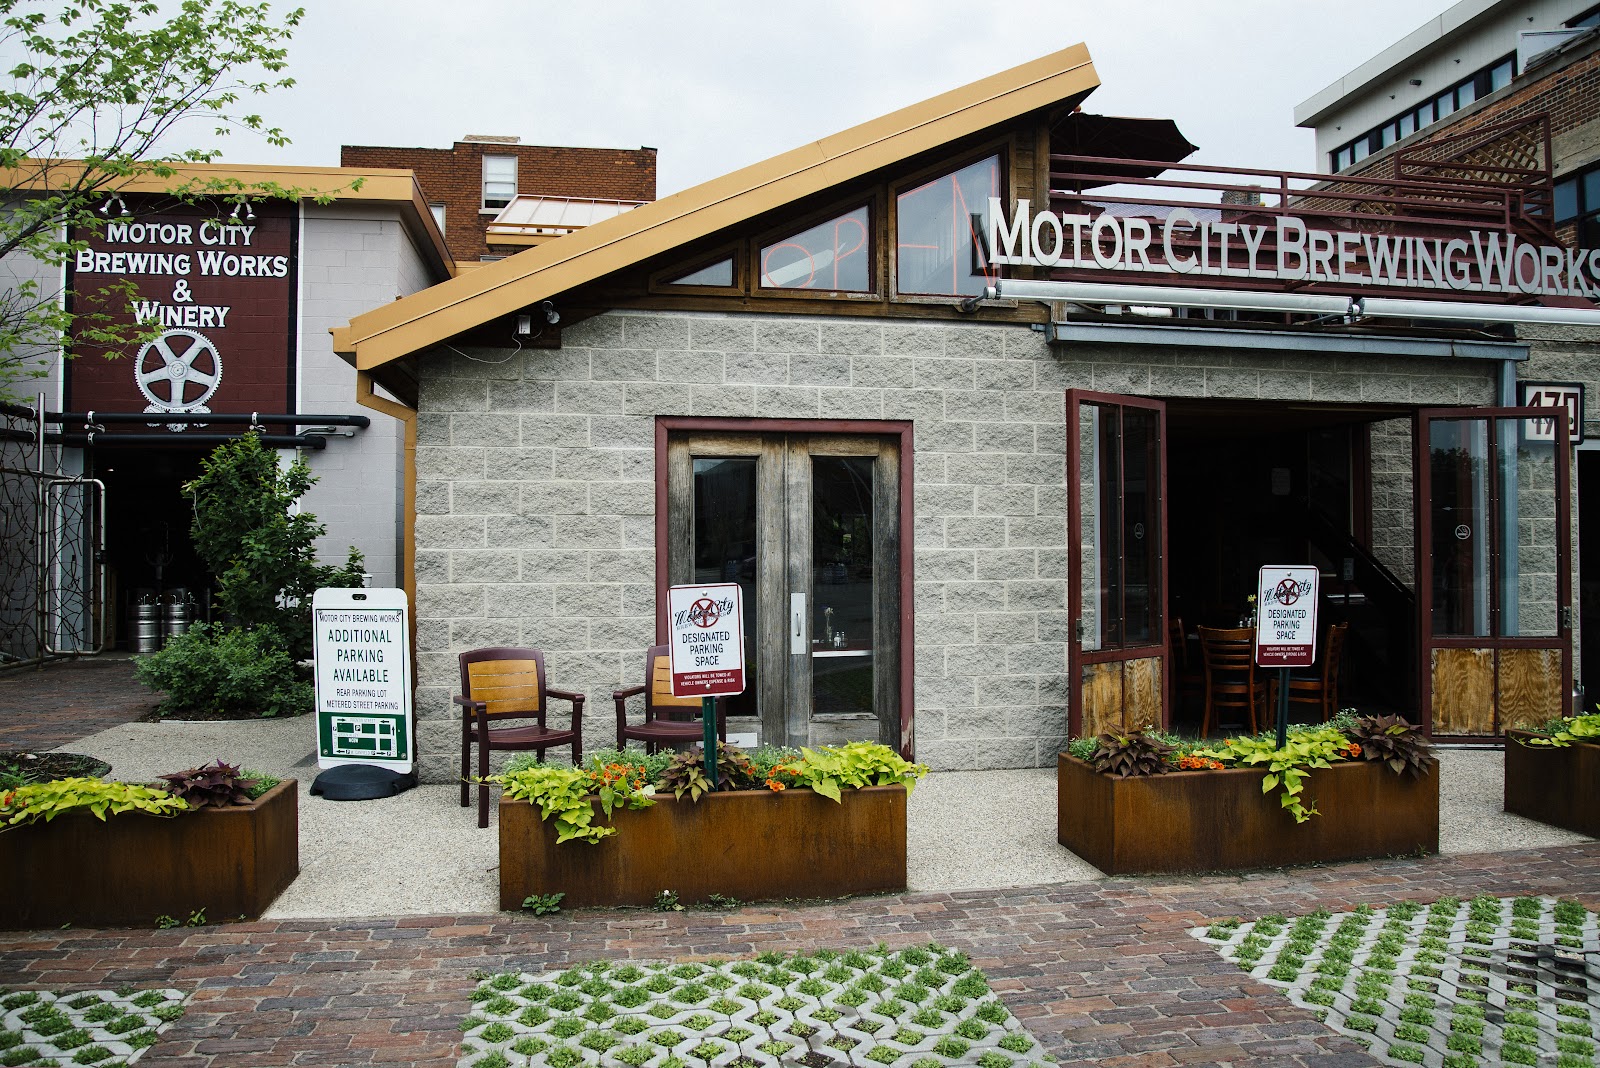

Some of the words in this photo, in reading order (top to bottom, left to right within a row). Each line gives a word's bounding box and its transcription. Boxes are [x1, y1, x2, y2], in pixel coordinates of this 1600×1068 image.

[106, 221, 193, 245] MOTOR
[199, 221, 256, 246] CITY
[988, 197, 1153, 271] MOTOR
[1163, 207, 1269, 276] CITY
[1276, 216, 1471, 290] BREWING
[75, 248, 191, 275] BREWING
[197, 250, 289, 278] WORKS
[172, 278, 194, 302] &
[131, 301, 231, 328] WINERY
[320, 614, 338, 623] MOTOR
[340, 614, 351, 622] CITY
[352, 614, 378, 622] BREWING
[380, 614, 400, 623] WORKS
[1268, 609, 1307, 619] DESIGNATED
[1273, 620, 1300, 629] PARKING
[328, 629, 392, 643] ADDITIONAL
[682, 631, 730, 644] DESIGNATED
[1276, 631, 1296, 640] SPACE
[689, 643, 724, 655] PARKING
[337, 649, 384, 663] PARKING
[694, 655, 719, 667] SPACE
[333, 668, 389, 683] AVAILABLE
[336, 688, 351, 697] REAR
[352, 689, 376, 698] PARKING
[377, 689, 387, 697] LOT
[326, 700, 352, 709] METERED
[353, 700, 373, 709] STREET
[374, 701, 399, 710] PARKING
